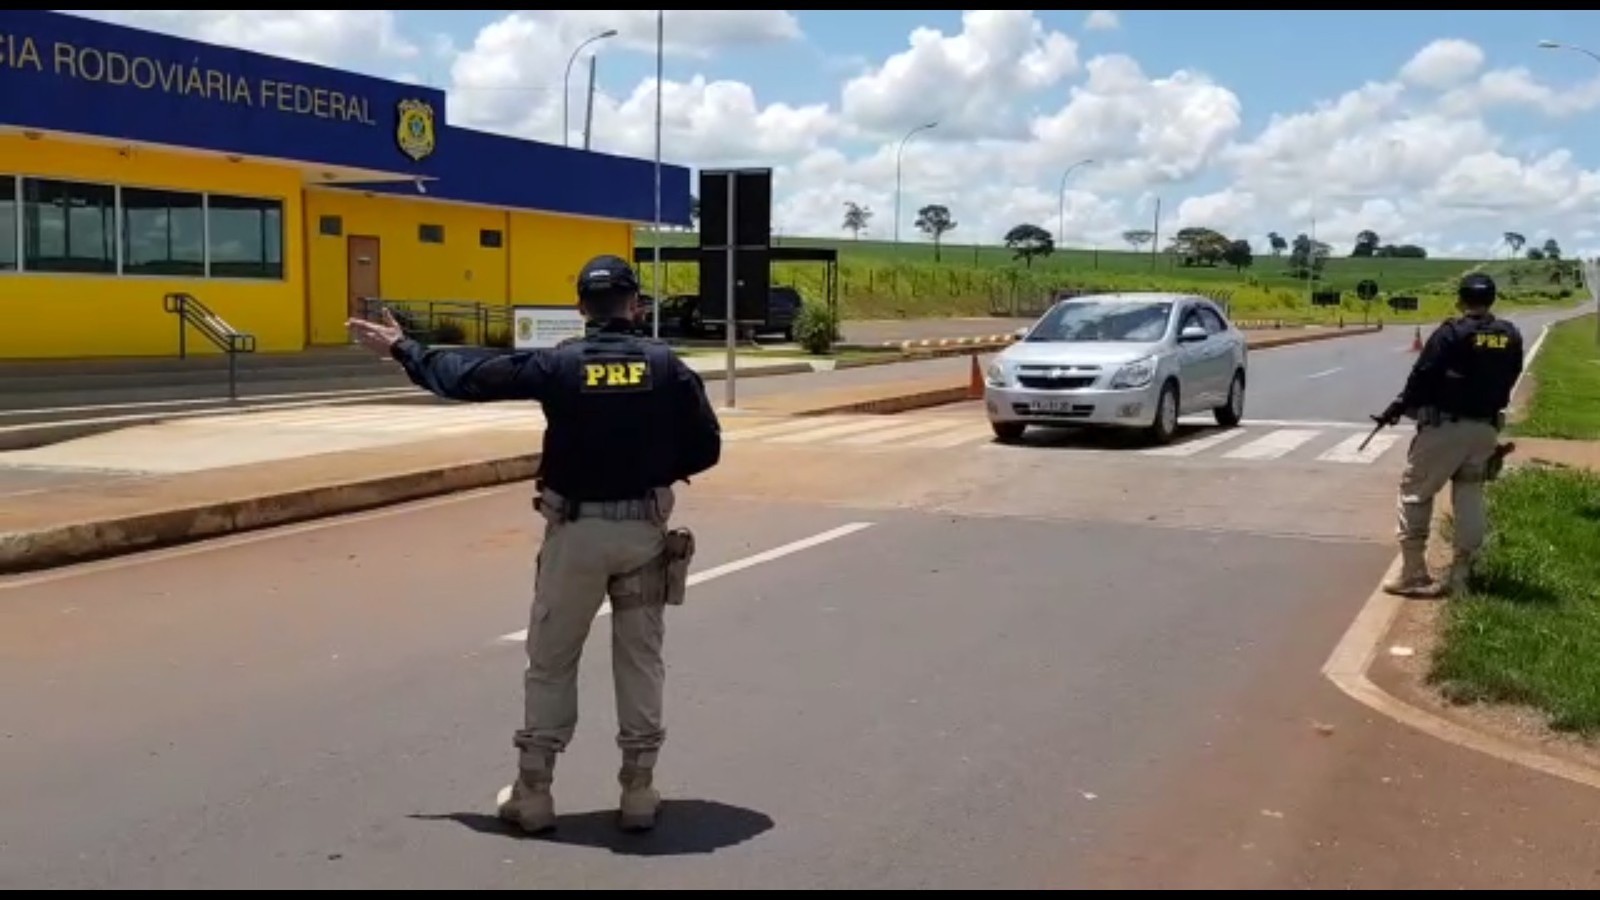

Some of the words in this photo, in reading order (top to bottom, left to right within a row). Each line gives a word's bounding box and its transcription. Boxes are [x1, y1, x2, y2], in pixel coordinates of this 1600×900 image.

[0, 34, 43, 71] IA
[54, 42, 252, 106] RODOVIÁRIA
[260, 80, 377, 126] FEDERAL
[1476, 333, 1508, 348] PRF
[585, 362, 646, 386] PRF
